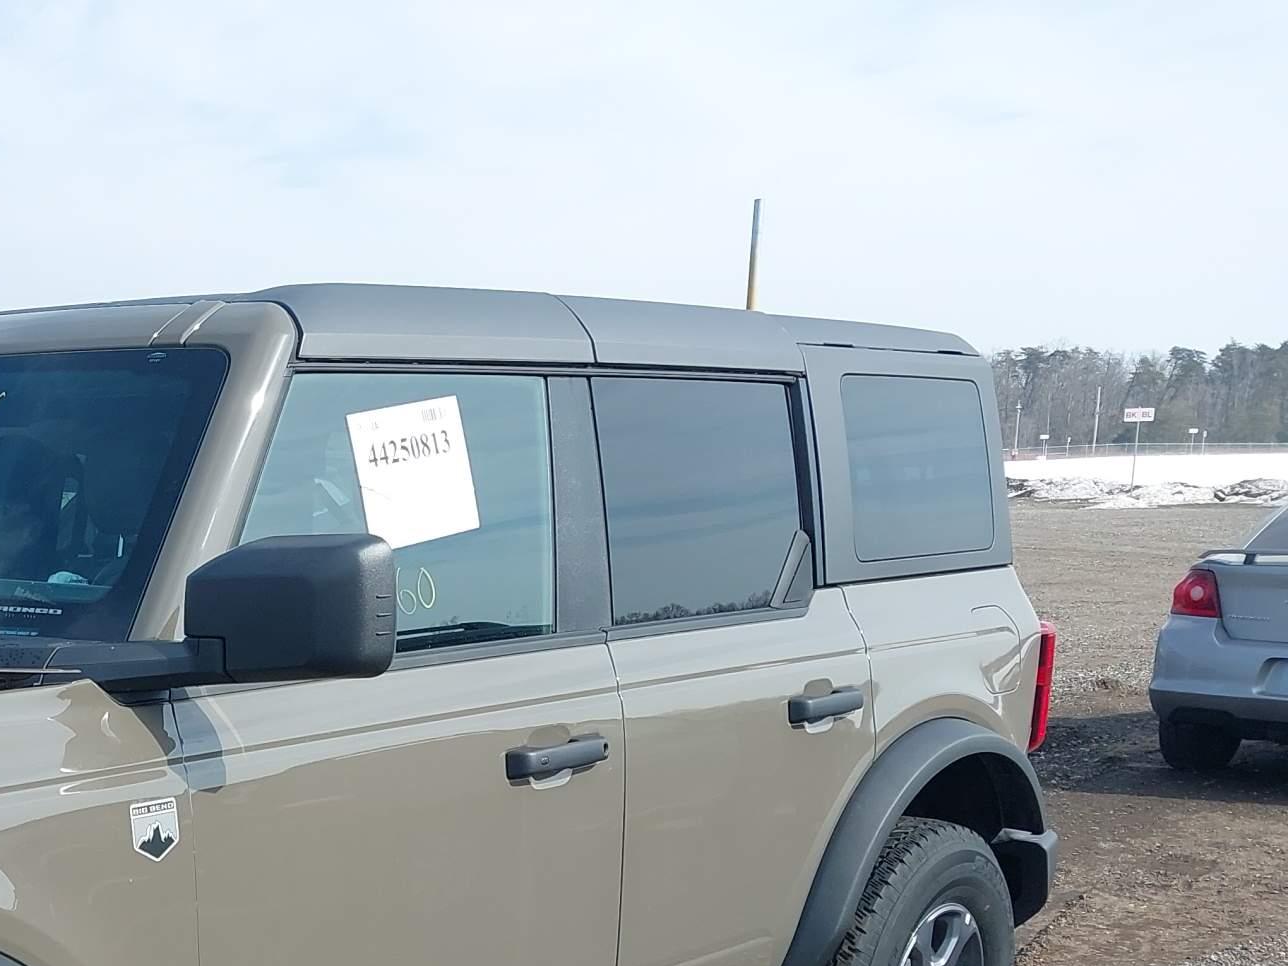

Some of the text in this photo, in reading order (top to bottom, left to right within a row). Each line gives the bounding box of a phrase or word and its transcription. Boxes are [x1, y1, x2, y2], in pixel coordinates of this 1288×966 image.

[368, 429, 451, 467] 44250813
[395, 567, 436, 615] 60
[132, 802, 174, 817] BIG BEND
